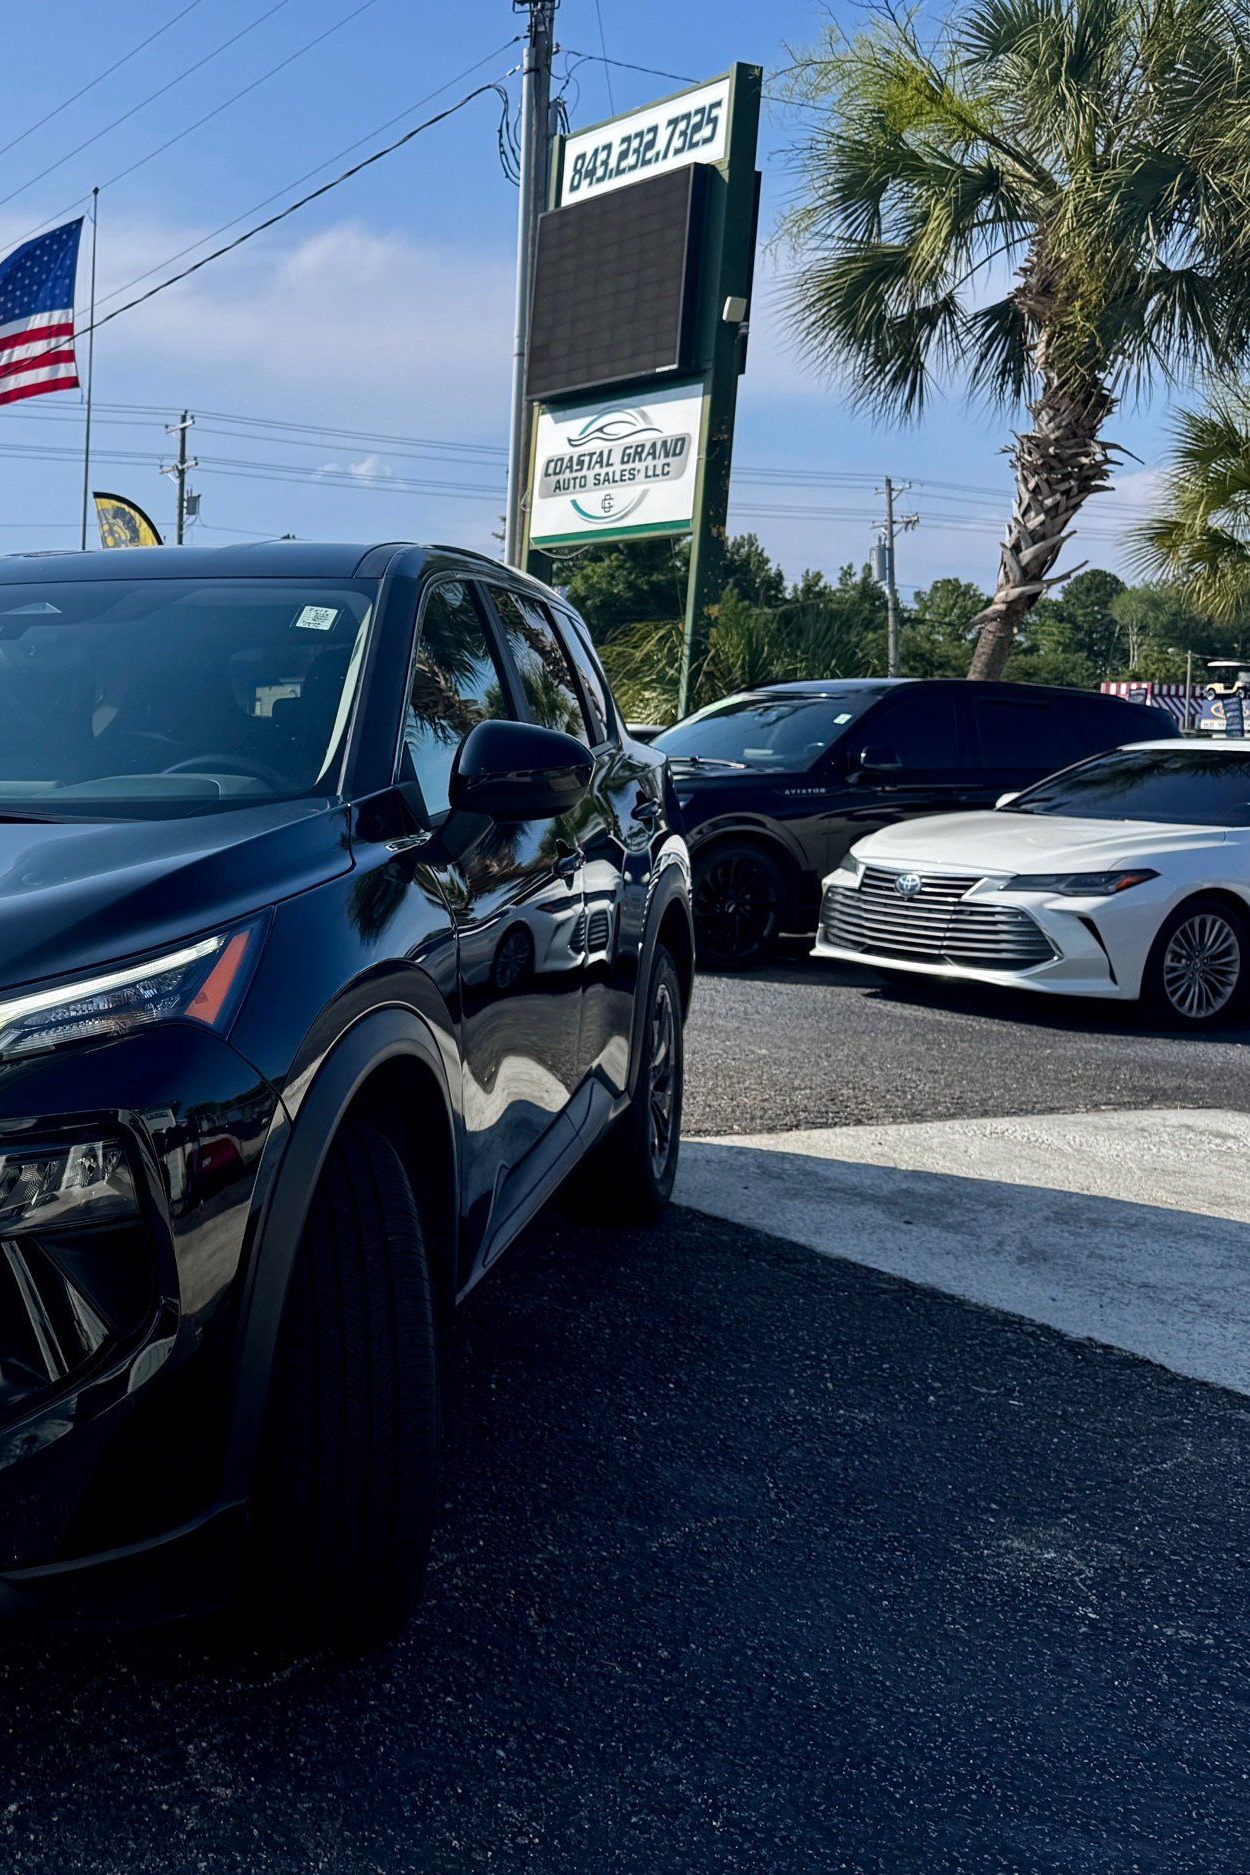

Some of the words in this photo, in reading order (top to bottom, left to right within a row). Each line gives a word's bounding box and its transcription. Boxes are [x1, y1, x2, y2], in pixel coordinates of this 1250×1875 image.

[568, 98, 723, 193] 843.232.7325
[543, 449, 615, 478] COASTAL
[619, 437, 687, 466] GRAND
[553, 475, 587, 493] AUTO
[644, 463, 671, 479] LLC
